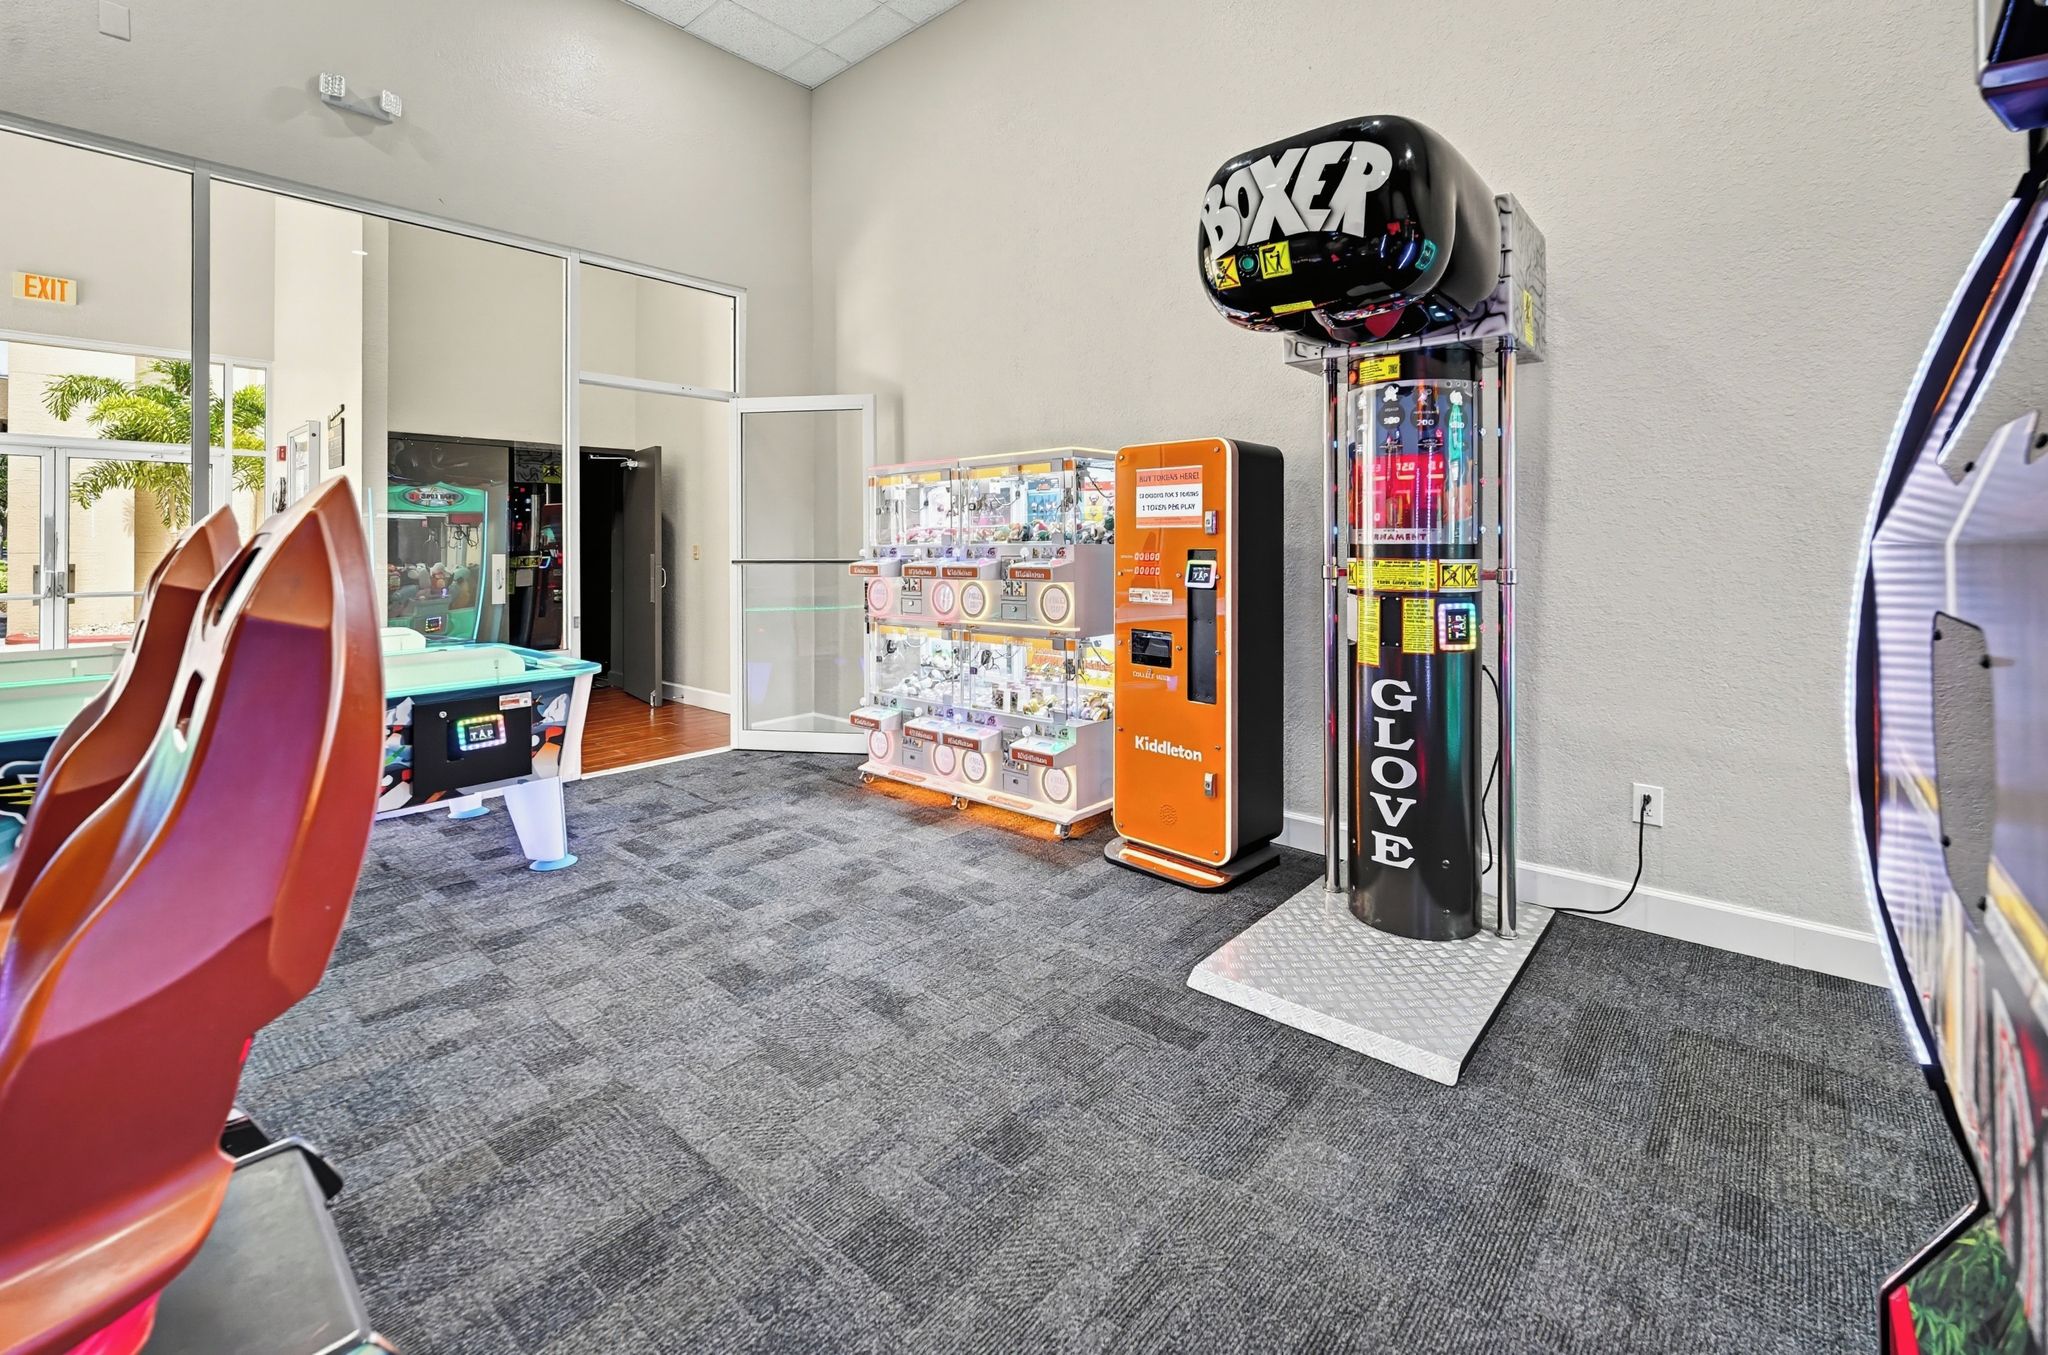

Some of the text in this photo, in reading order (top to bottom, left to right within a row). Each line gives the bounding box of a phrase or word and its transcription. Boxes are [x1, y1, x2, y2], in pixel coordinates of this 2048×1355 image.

[1200, 140, 1393, 261] BOXER
[24, 274, 69, 302] EXIT
[1139, 472, 1200, 483] BUY TOKENS HERE!
[1168, 503, 1180, 511] PER
[1192, 571, 1209, 581] TAP
[1455, 614, 1467, 639] TAP
[470, 728, 494, 741] TAP
[1134, 734, 1203, 763] Kiddleton
[1369, 678, 1418, 870] GLOVE
